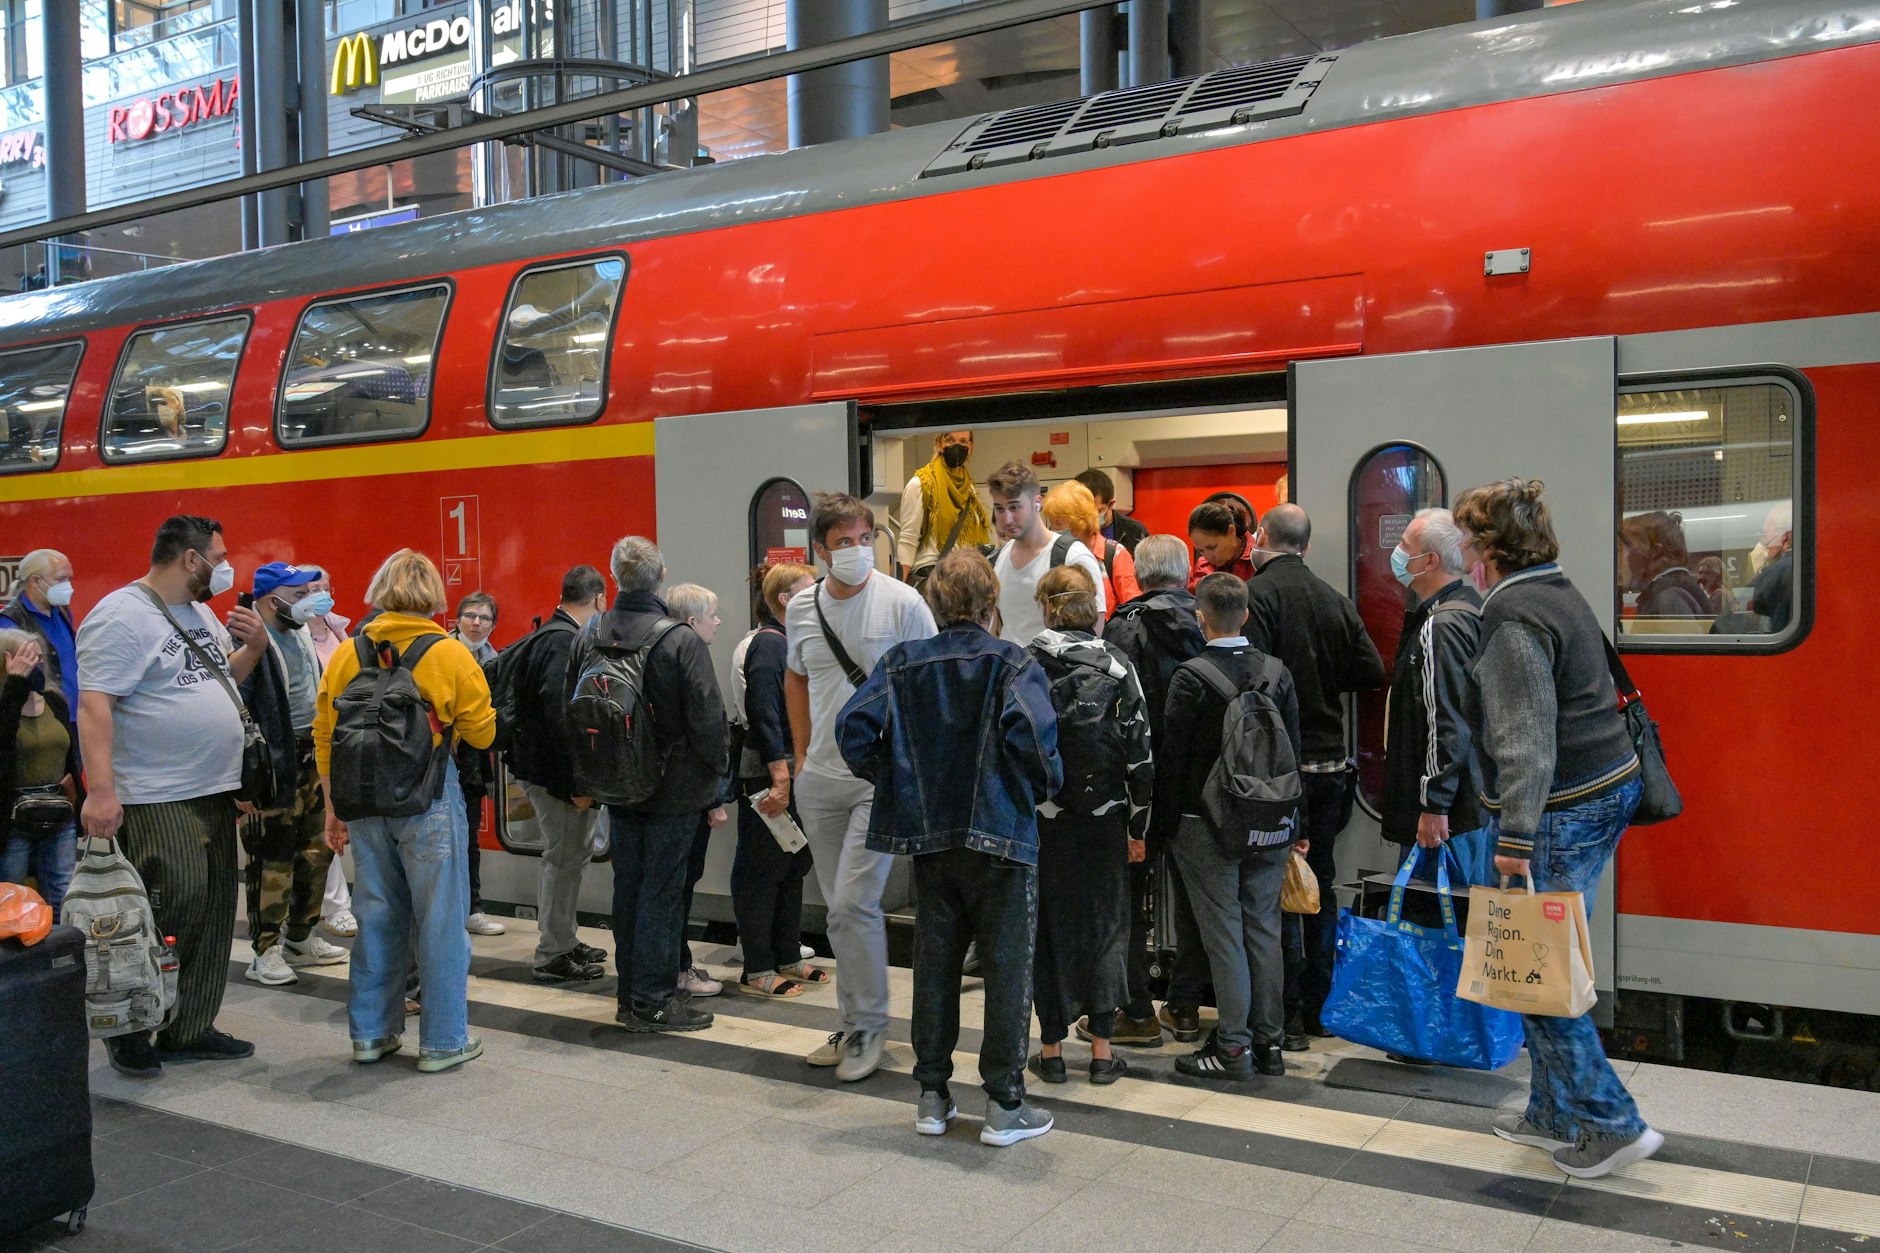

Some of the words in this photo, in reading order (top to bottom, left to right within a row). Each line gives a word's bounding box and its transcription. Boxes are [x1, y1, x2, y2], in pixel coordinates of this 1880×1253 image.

[424, 72, 434, 83] UG
[449, 501, 466, 555] 1
[162, 638, 182, 657] THE
[177, 674, 198, 687] LOS
[1247, 827, 1290, 847] PUMA
